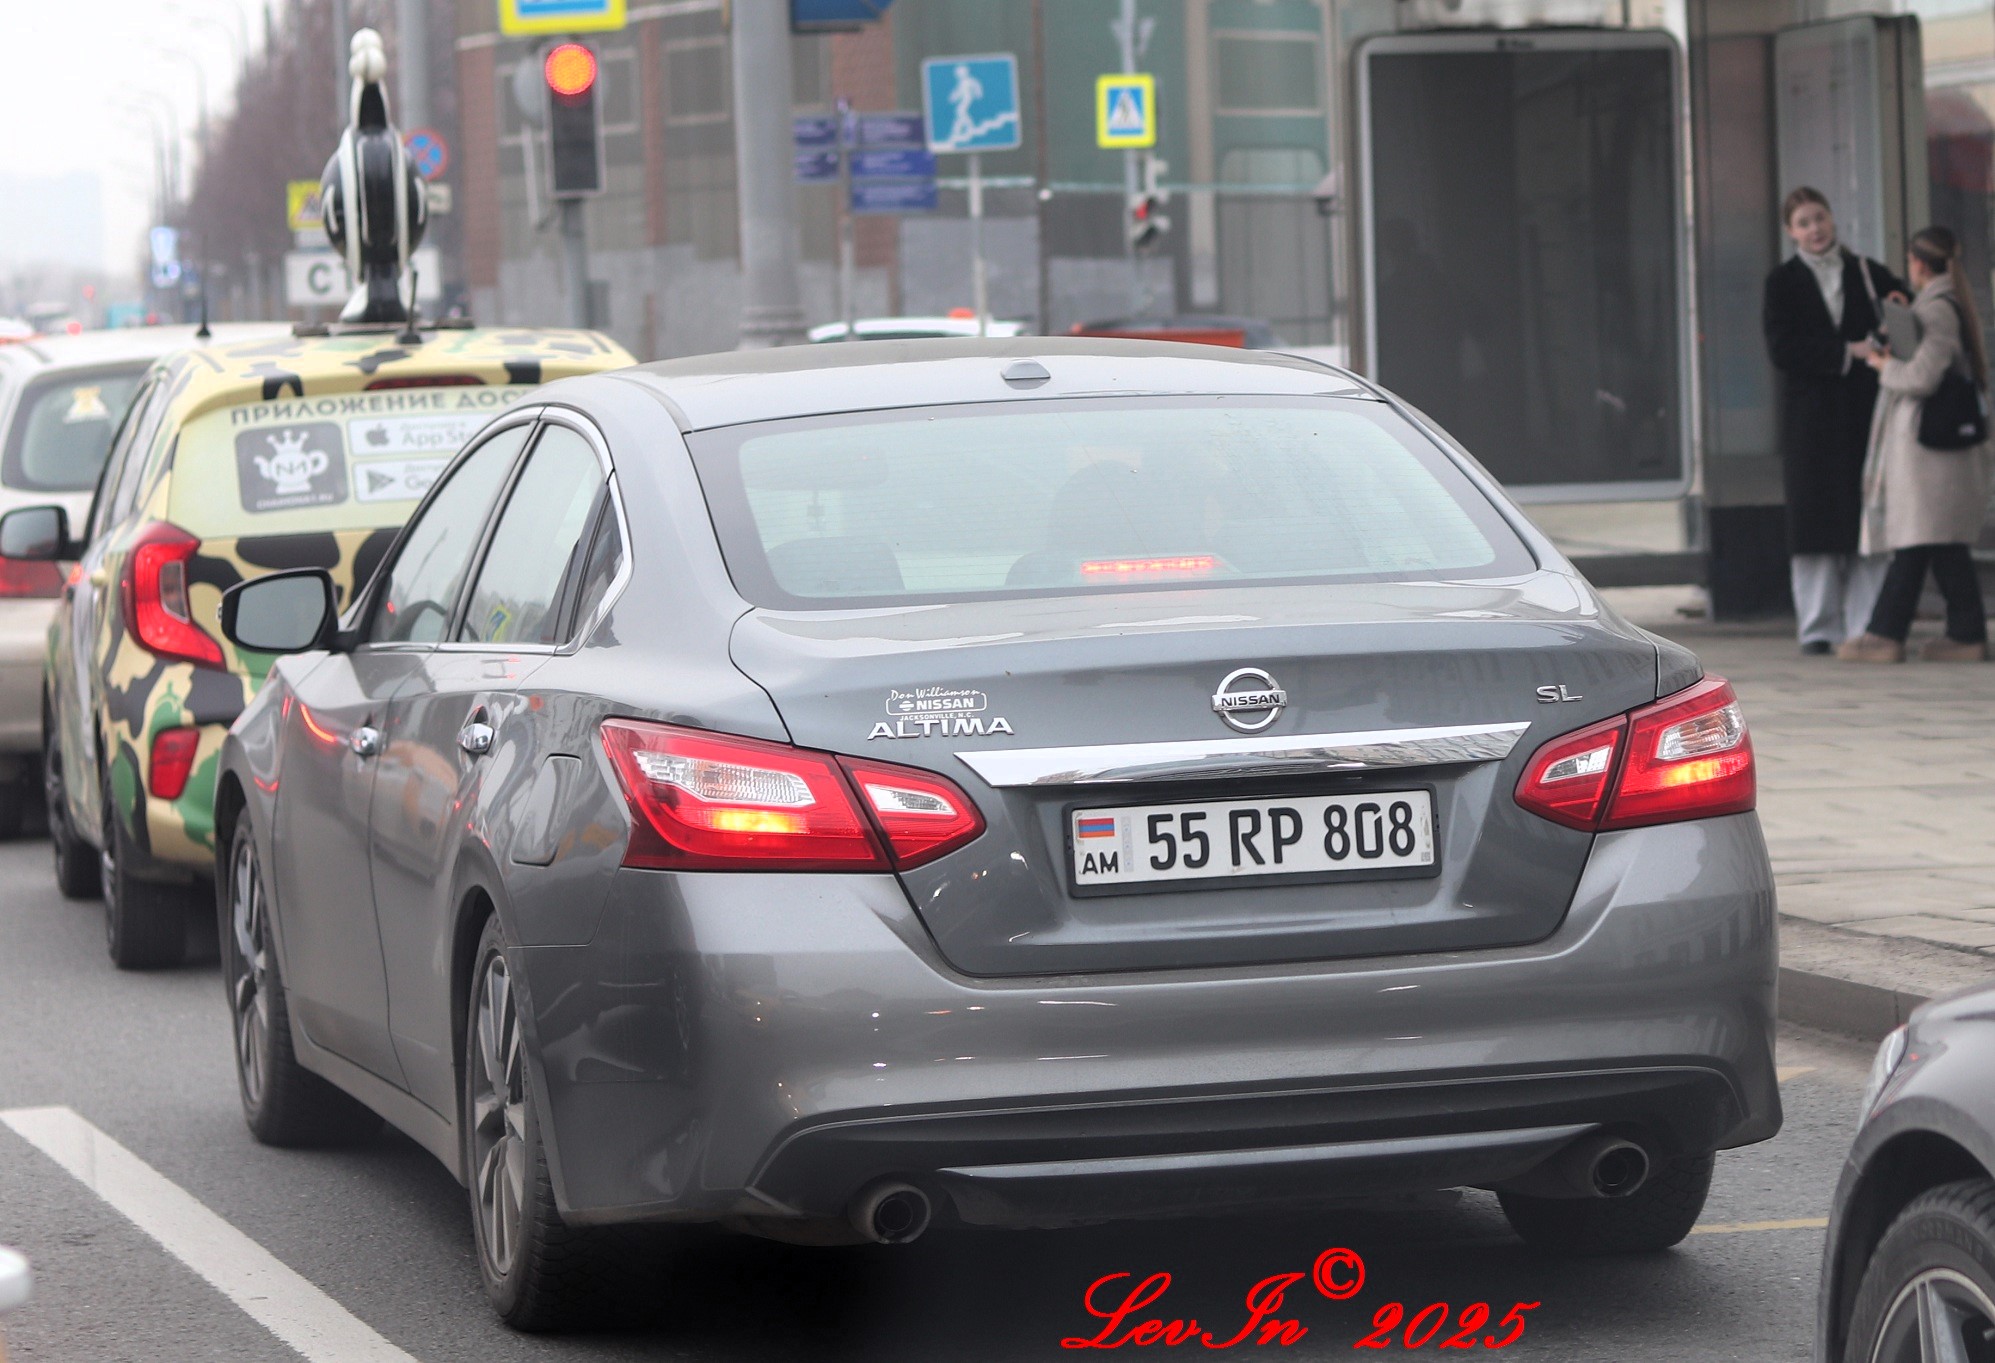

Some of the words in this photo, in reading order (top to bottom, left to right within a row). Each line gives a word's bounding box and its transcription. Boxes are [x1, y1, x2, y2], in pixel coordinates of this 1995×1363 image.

[231, 391, 446, 425] ПРИЛОЖЕНИЕ
[456, 389, 525, 409] ДОС
[890, 689, 915, 701] Don
[915, 686, 980, 699] Williamson
[1221, 694, 1280, 707] NISSAN
[1536, 684, 1583, 704] SL
[916, 697, 974, 711] NISSAN
[900, 712, 957, 721] JACKSONVILLE,
[957, 711, 975, 719] N.C.
[867, 717, 1015, 740] ALTIMA
[1147, 811, 1210, 870] 55
[1229, 806, 1303, 867] RP
[1323, 800, 1416, 861] 808
[1082, 850, 1119, 875] AM
